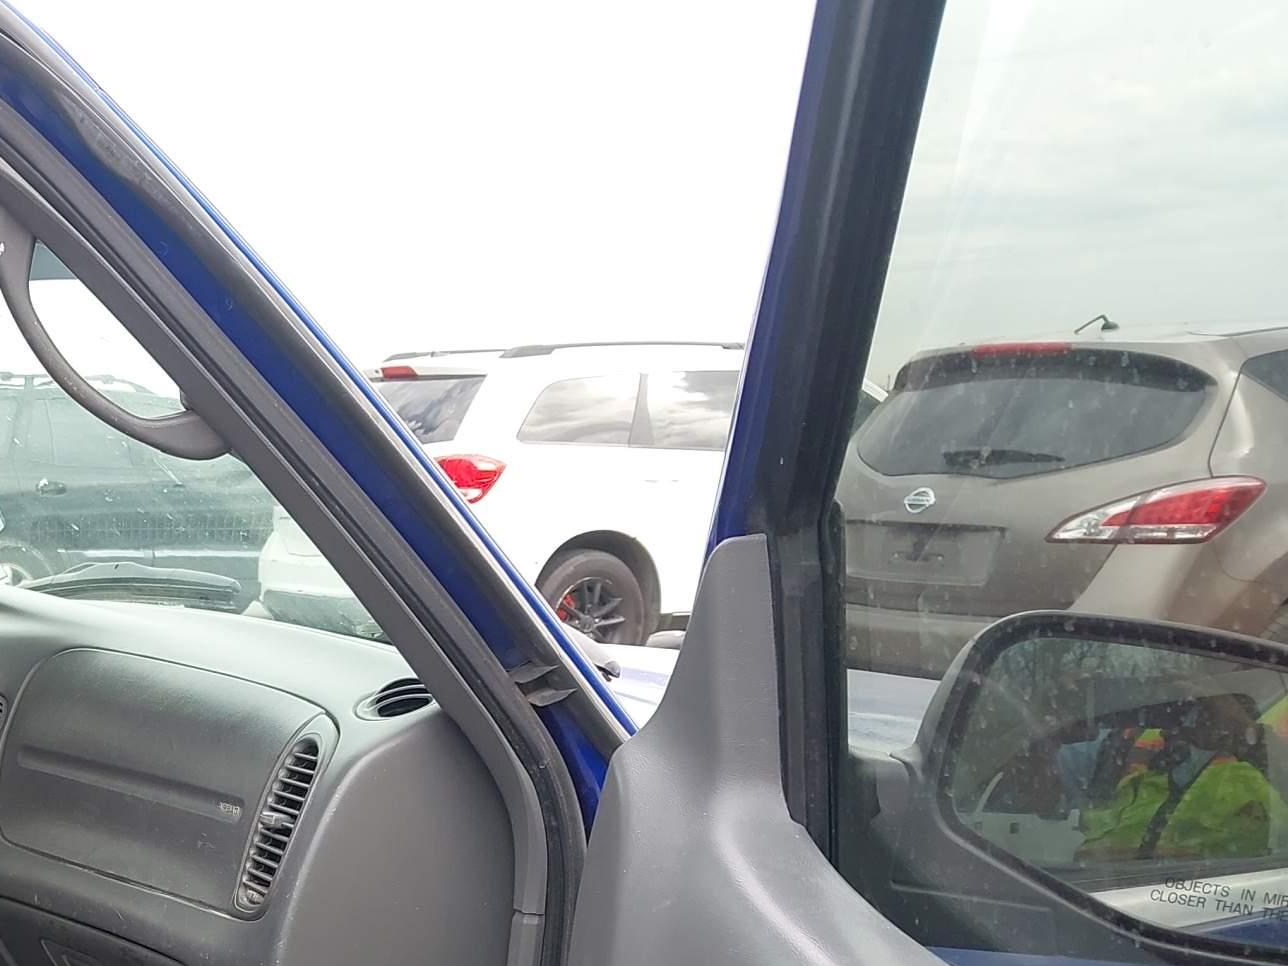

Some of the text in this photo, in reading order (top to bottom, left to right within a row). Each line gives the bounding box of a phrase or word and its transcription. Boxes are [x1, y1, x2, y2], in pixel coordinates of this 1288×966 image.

[1150, 889, 1207, 909] CLOSER
[1215, 899, 1254, 916] THAN
[1165, 877, 1231, 898] OBJECTS
[1241, 888, 1256, 902] IN
